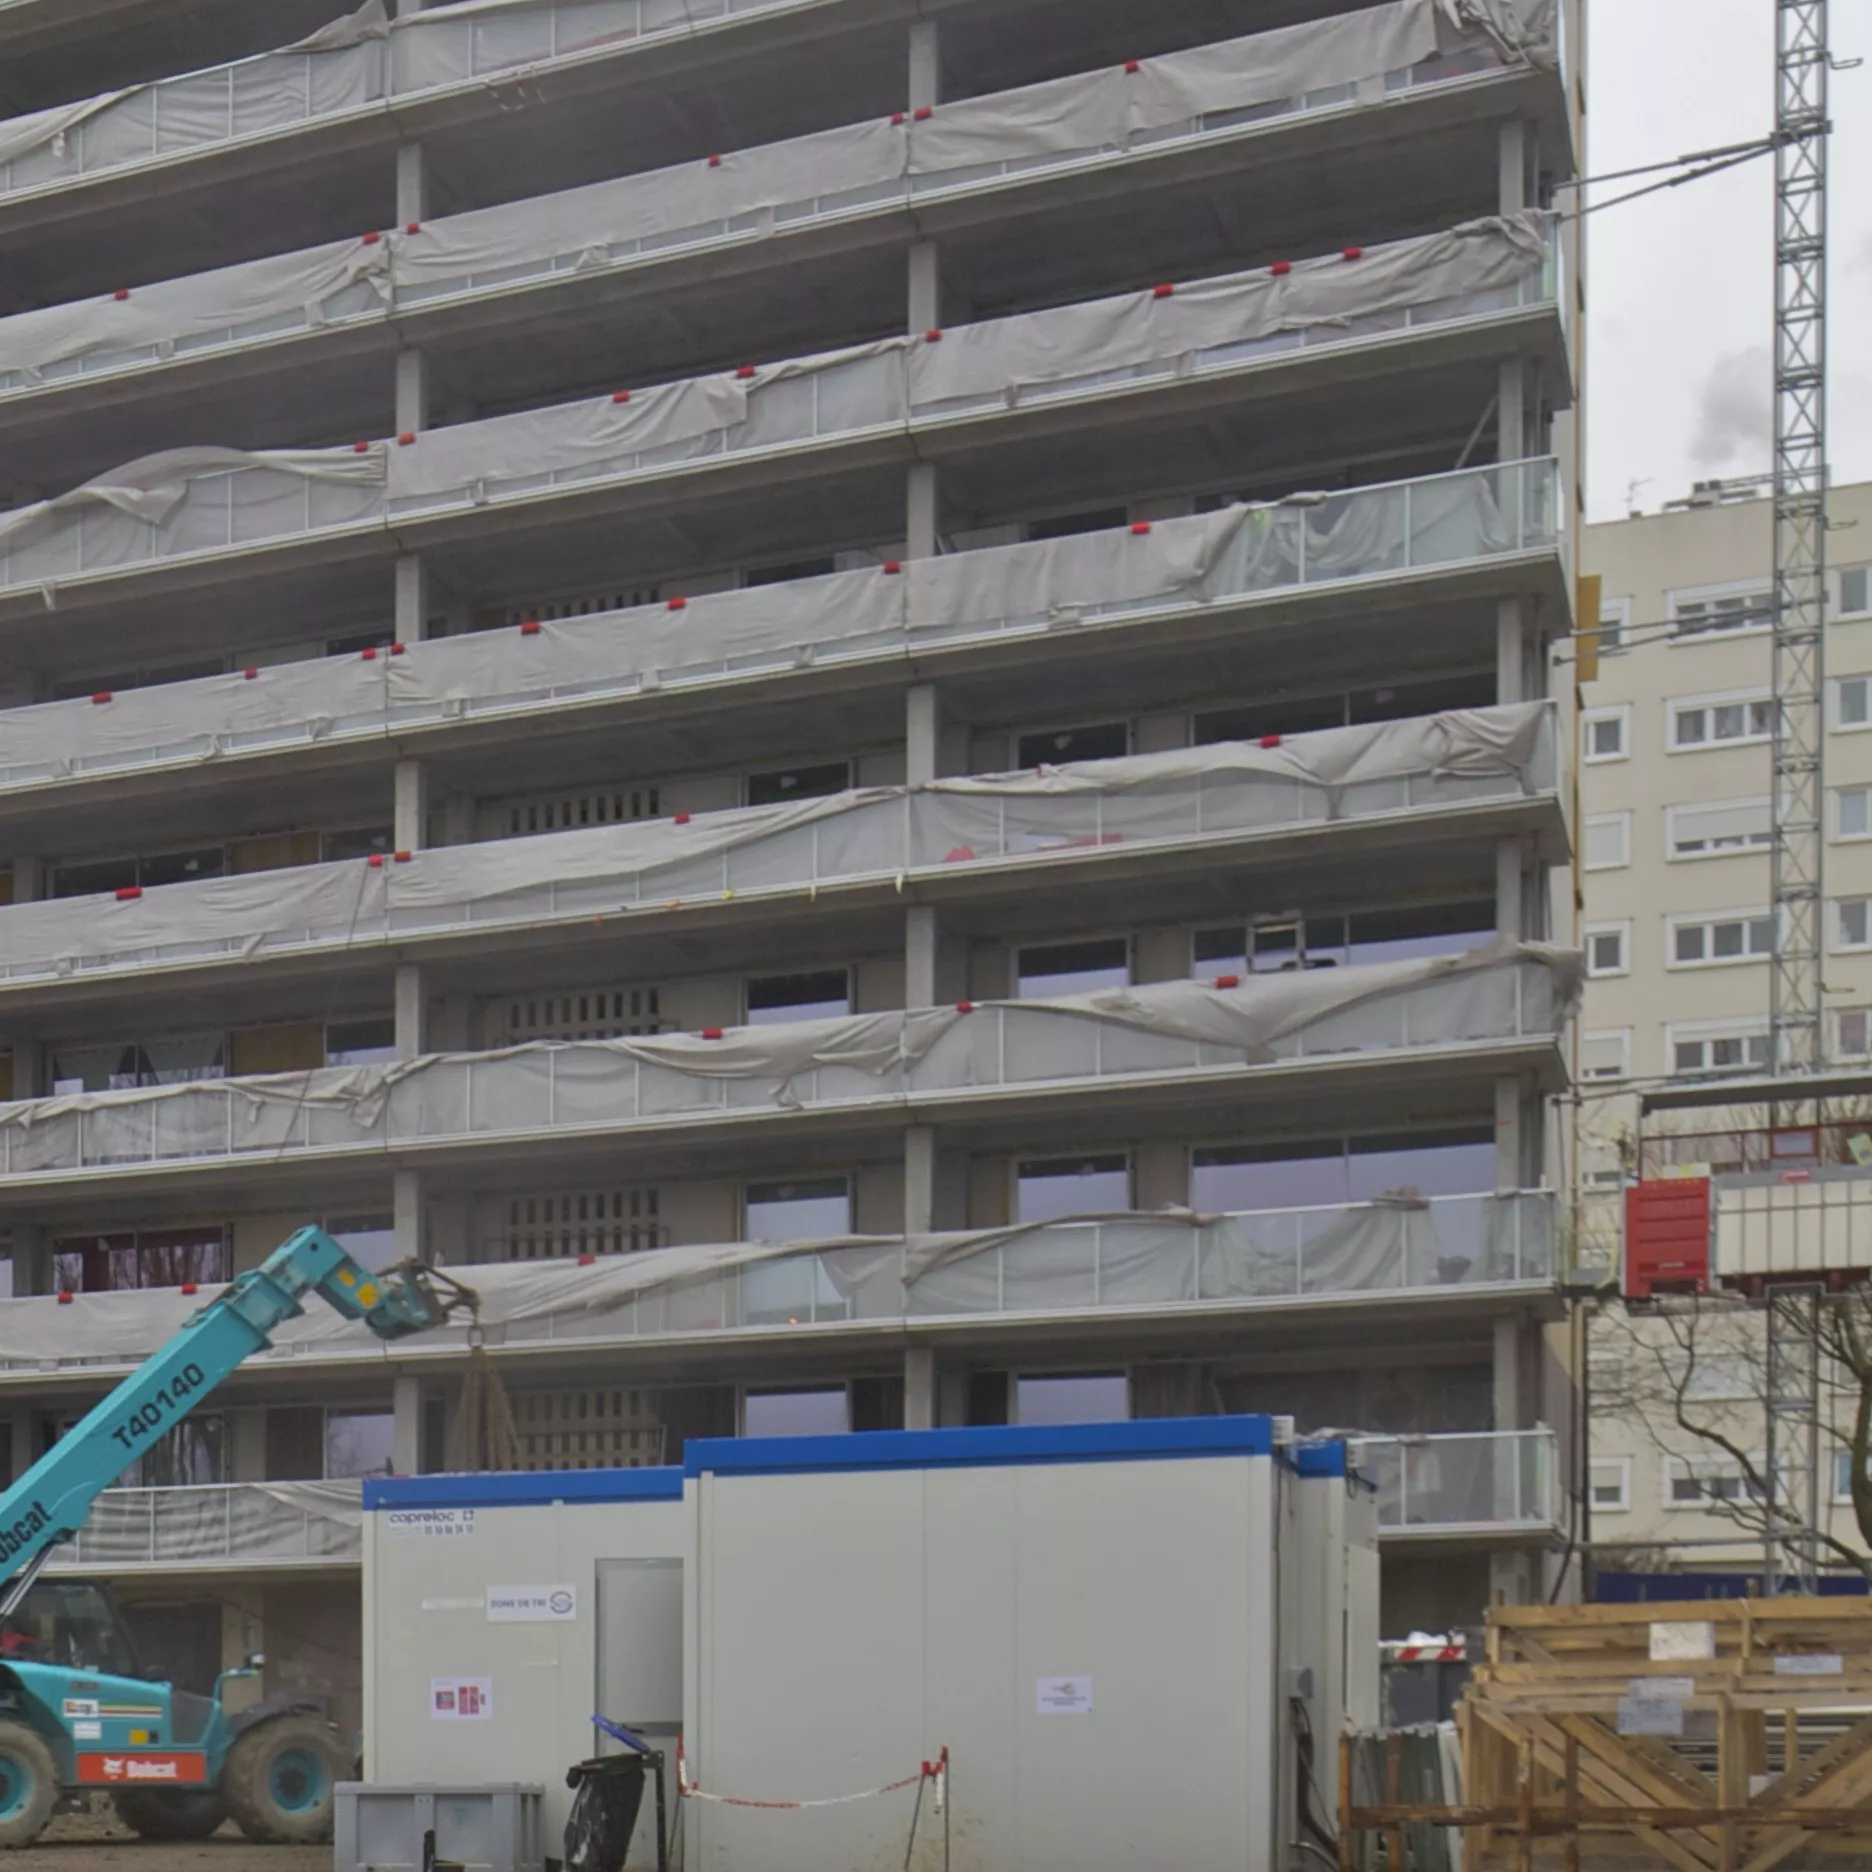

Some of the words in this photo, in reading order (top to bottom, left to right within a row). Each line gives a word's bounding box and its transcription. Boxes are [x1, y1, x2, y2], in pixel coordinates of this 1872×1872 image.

[112, 1363, 205, 1449] T40140
[517, 1598, 530, 1609] DE
[532, 1598, 547, 1608] TRI
